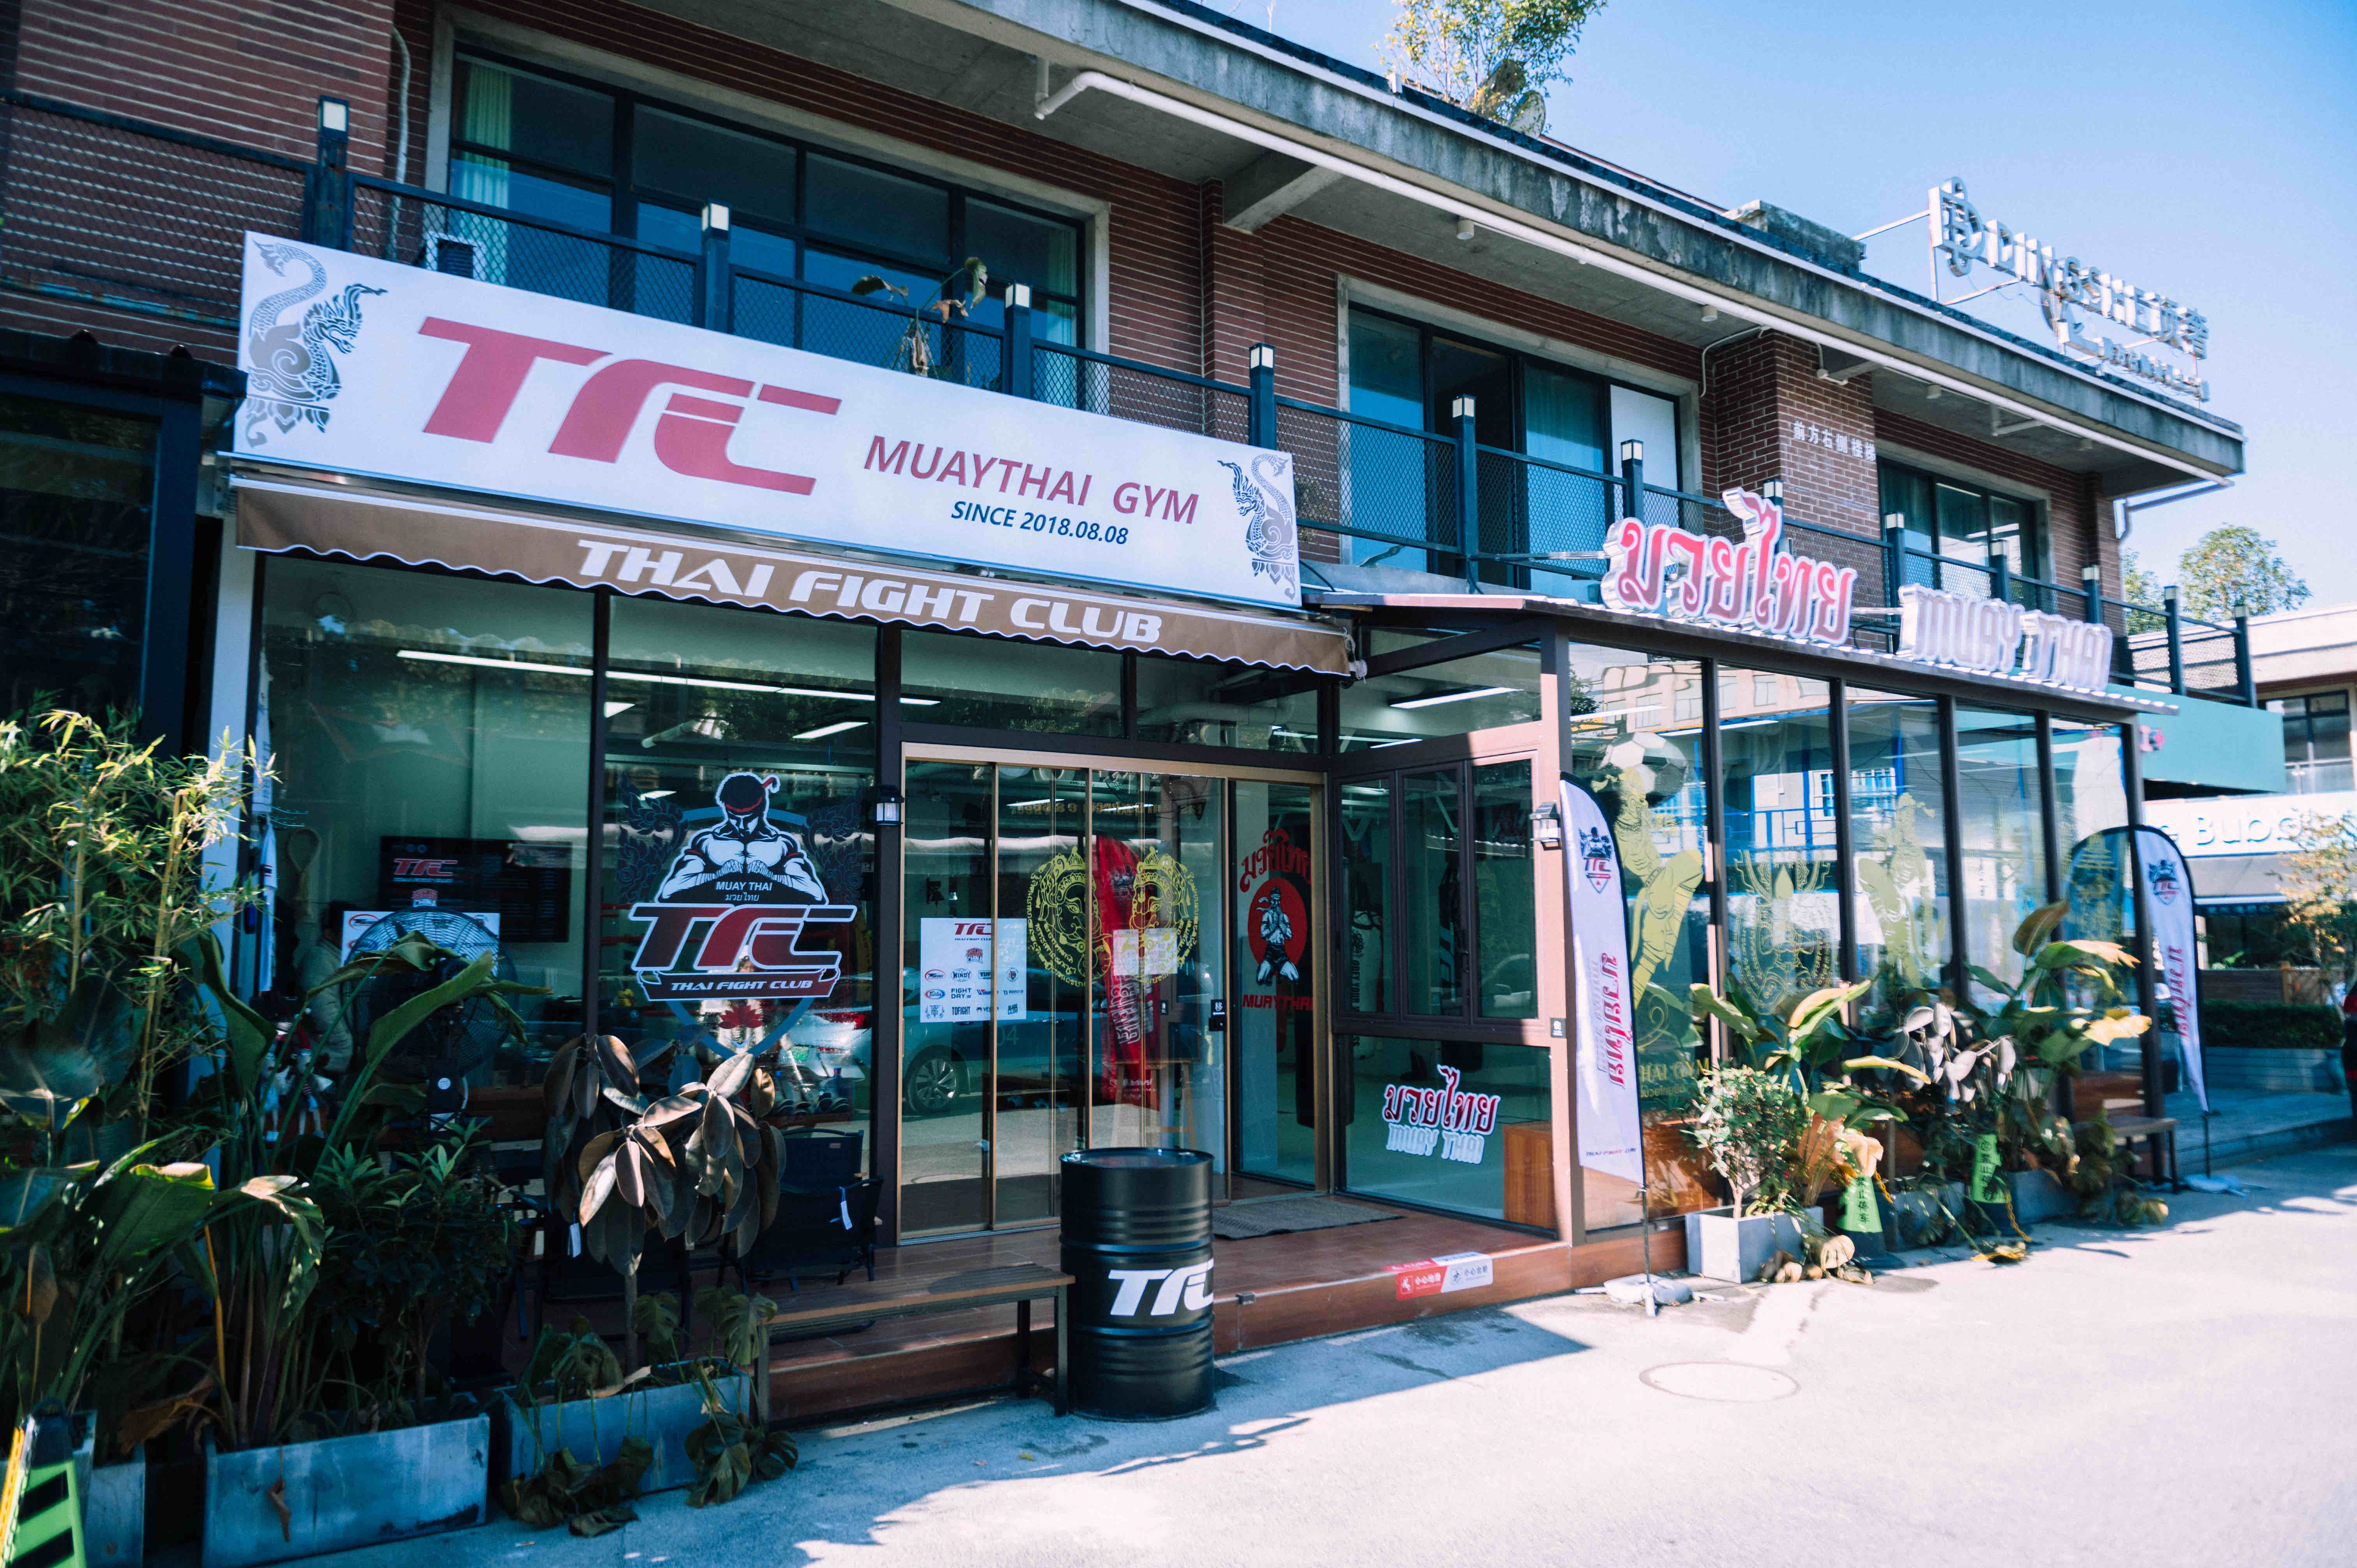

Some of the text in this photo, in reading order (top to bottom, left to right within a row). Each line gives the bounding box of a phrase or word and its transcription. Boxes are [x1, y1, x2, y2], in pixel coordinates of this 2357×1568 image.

[864, 435, 1200, 524] MUAYTHAI GYM
[951, 501, 1129, 545] SINCE 2018.08.08
[1604, 487, 1858, 646] มวยไทย
[575, 539, 1163, 645] THAI FIGHT CLUB
[1898, 583, 2113, 692] MUAY THAI
[716, 881, 773, 891] MUAY THAI
[725, 892, 760, 902] มวยไทย
[671, 980, 813, 991] THAI FIGHT CLUB
[952, 1007, 970, 1015] TOFIGHT
[1382, 1063, 1501, 1136] มวยไทย
[1386, 1123, 1485, 1164] MUAY THAI
